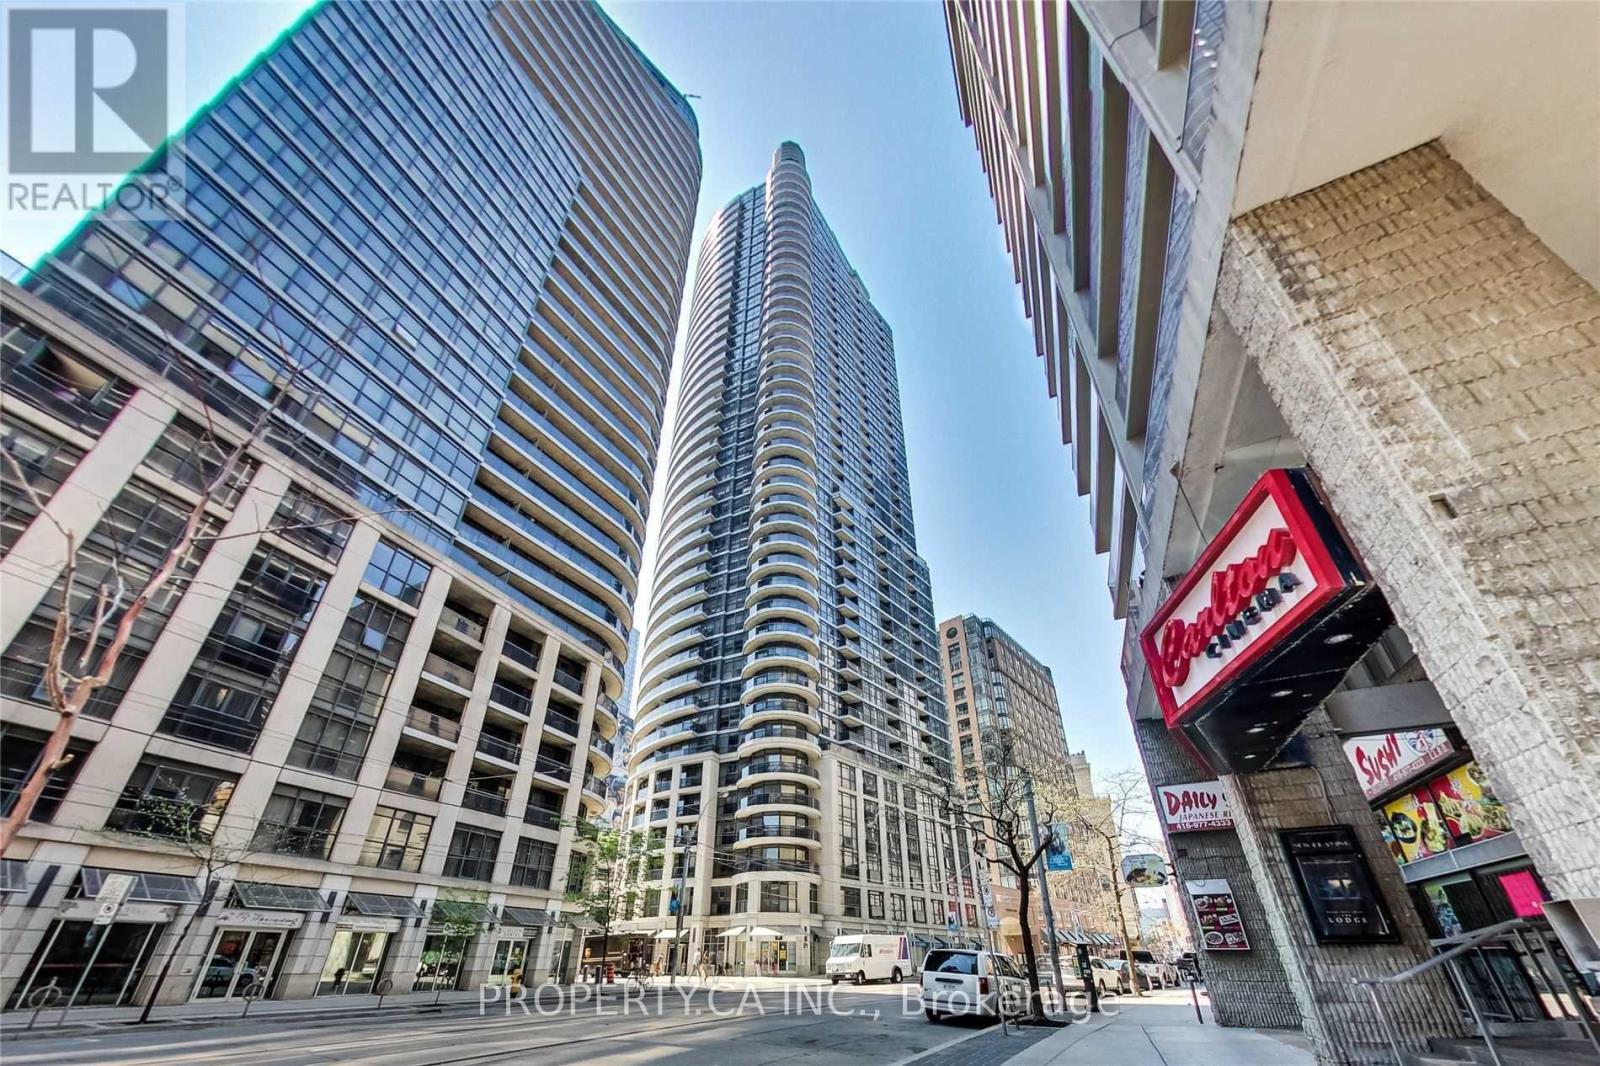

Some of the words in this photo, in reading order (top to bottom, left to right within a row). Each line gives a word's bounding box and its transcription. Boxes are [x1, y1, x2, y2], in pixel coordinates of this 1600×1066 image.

[1162, 528, 1297, 687] Carlton
[1206, 572, 1303, 658] CINEMA
[1163, 790, 1217, 816] DAILY
[1180, 811, 1218, 822] JAPANESE
